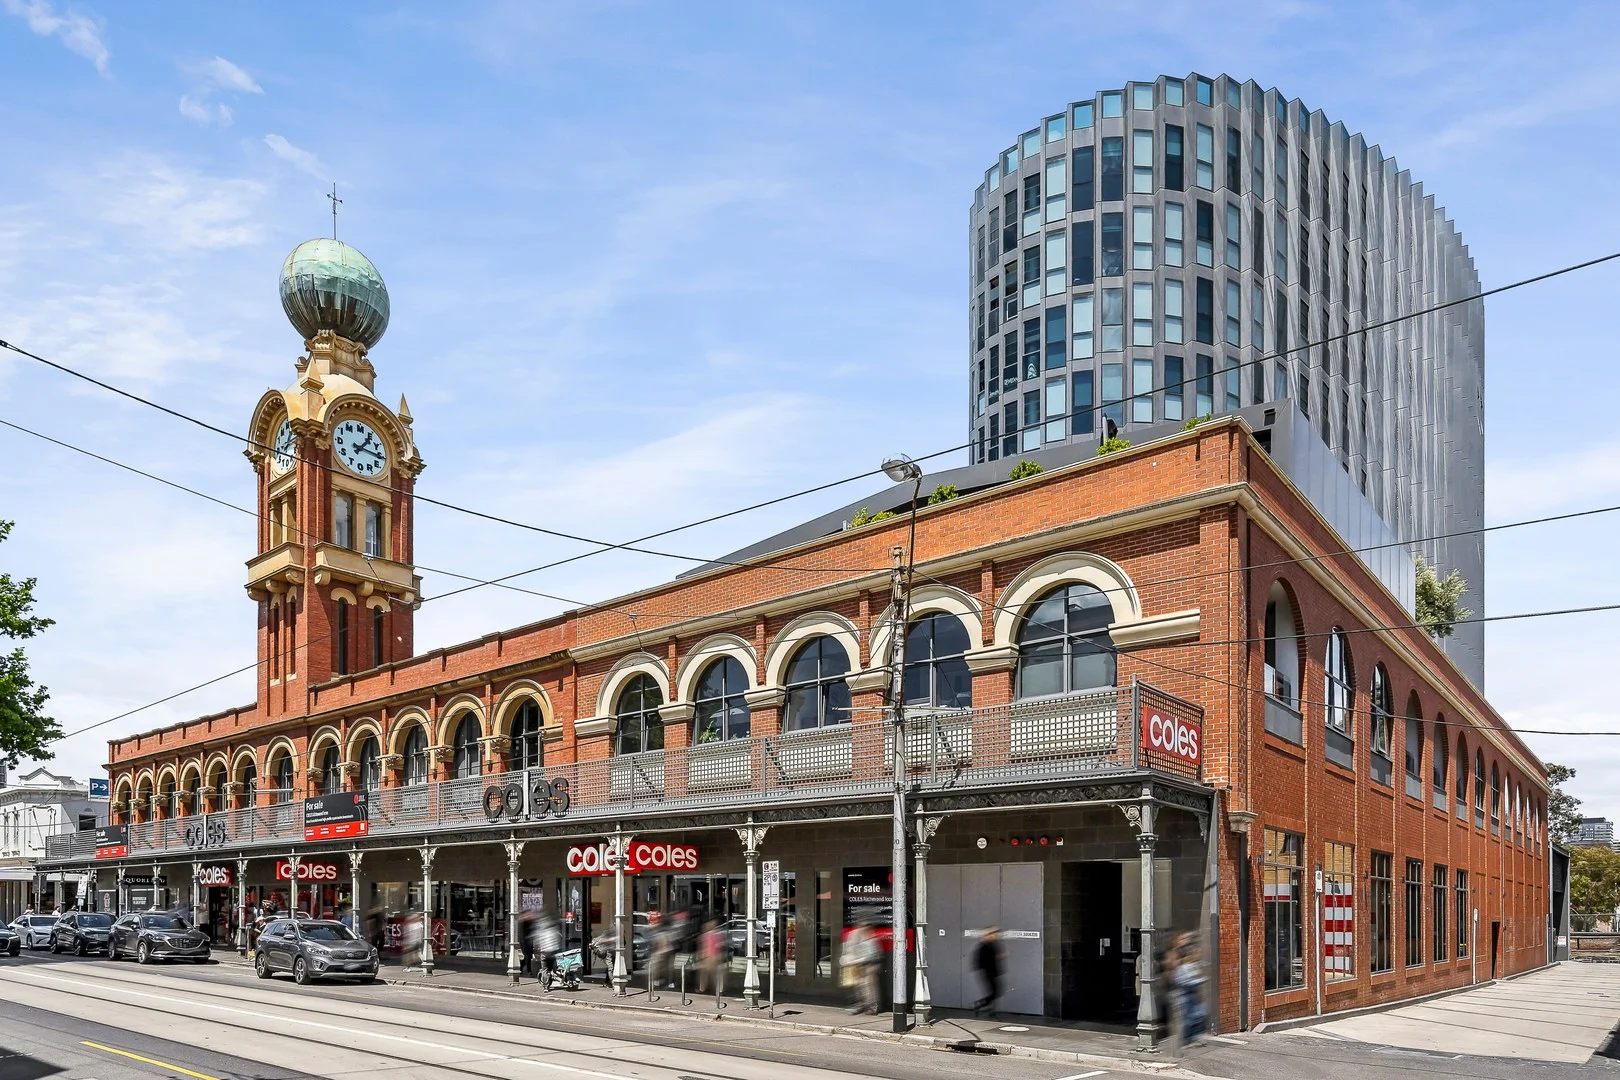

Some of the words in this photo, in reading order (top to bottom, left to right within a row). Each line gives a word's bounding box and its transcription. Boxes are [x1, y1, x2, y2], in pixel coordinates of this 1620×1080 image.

[1149, 714, 1198, 759] coles
[92, 782, 98, 790] P
[306, 802, 314, 811] For
[314, 800, 324, 810] sale
[483, 771, 570, 823] coles
[635, 844, 698, 869] coles
[200, 866, 227, 885] coles
[280, 863, 337, 879] coles
[848, 884, 861, 893] For
[863, 883, 881, 893] sale
